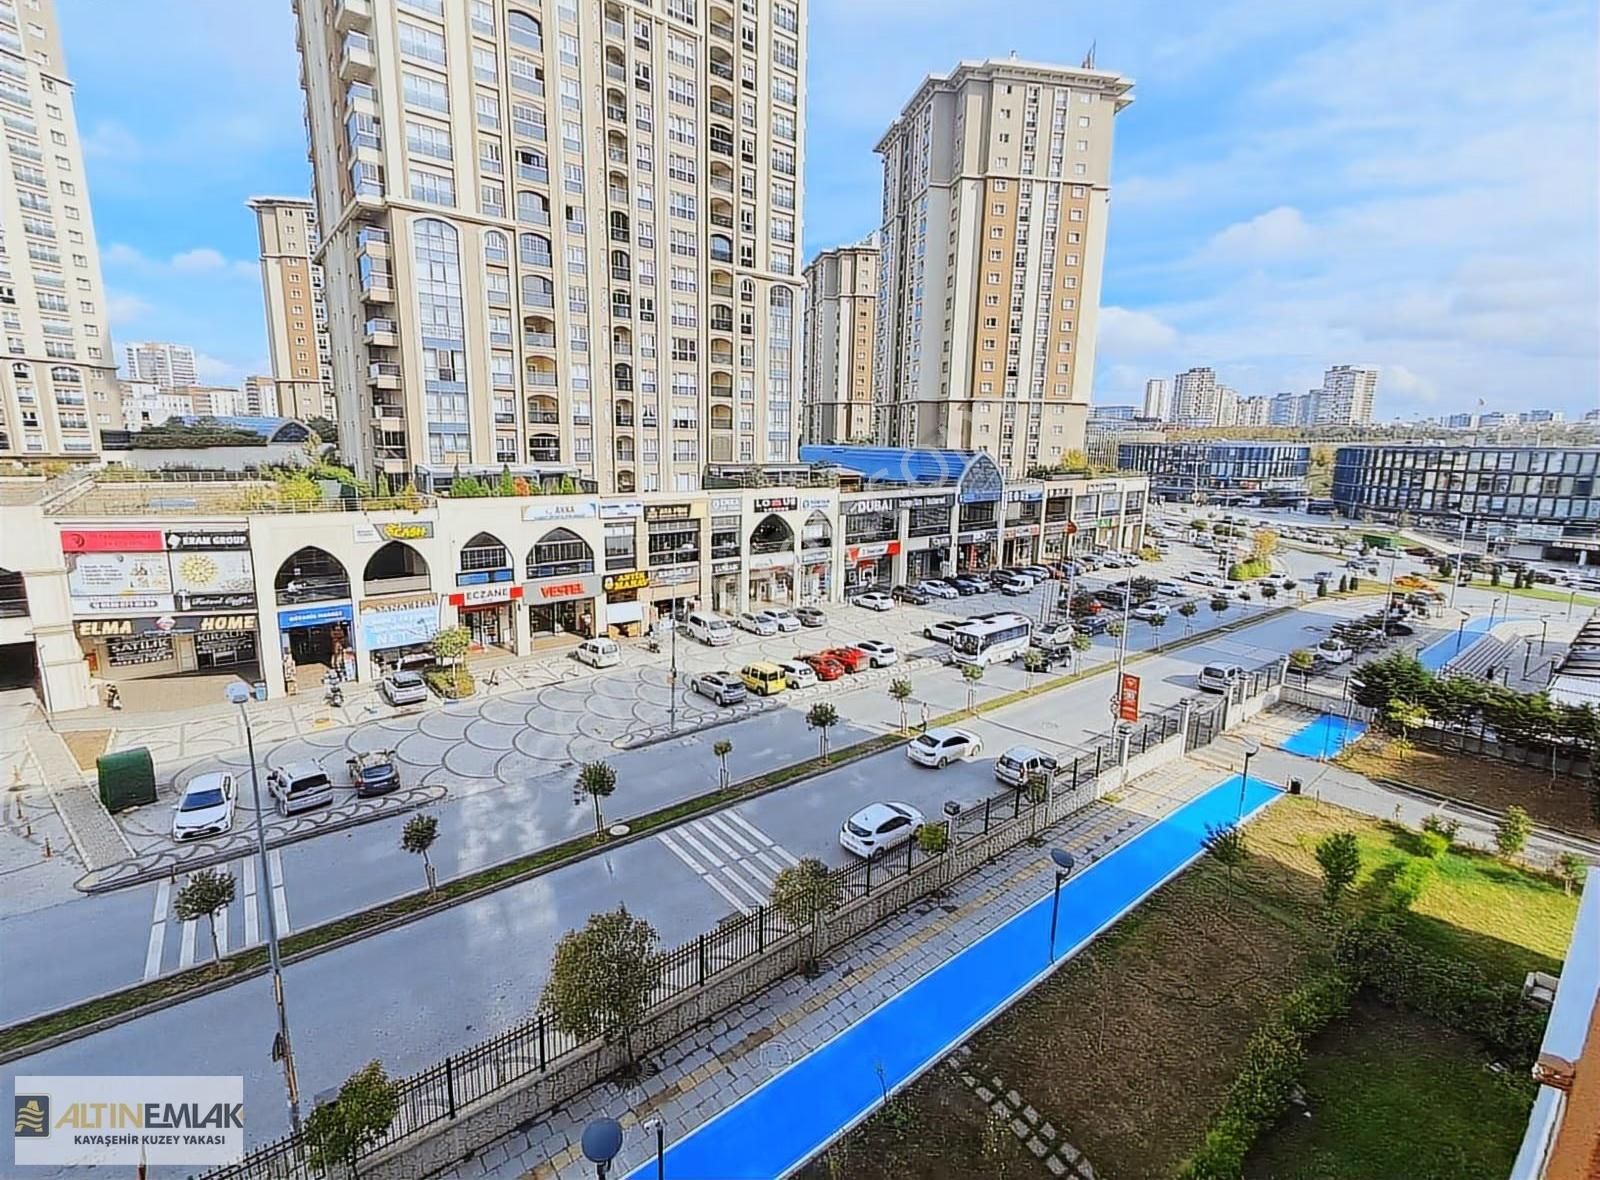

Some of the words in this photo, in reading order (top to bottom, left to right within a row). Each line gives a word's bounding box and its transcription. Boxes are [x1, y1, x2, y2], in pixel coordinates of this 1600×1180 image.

[466, 587, 508, 601] ECZANE
[541, 583, 585, 598] VESTEL
[79, 621, 133, 636] ELMA
[201, 615, 256, 631] HOME
